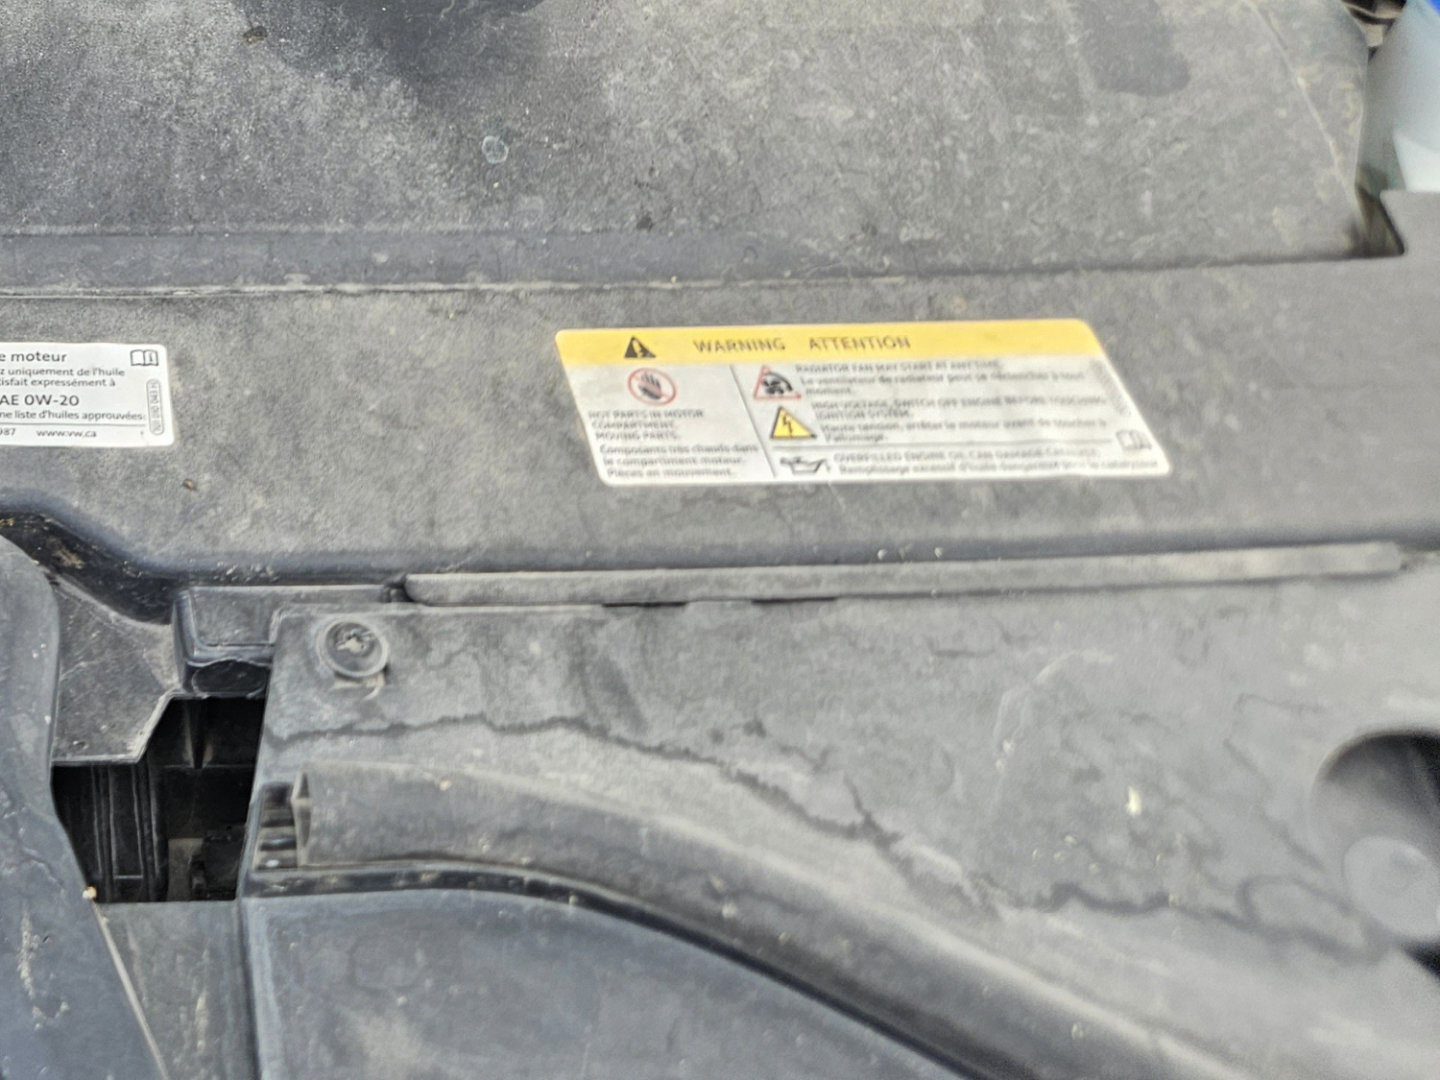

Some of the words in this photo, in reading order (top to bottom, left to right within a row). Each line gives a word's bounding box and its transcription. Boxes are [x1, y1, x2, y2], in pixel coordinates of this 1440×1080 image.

[693, 338, 786, 353] WARNING
[809, 336, 911, 351] ATTENTION
[11, 351, 67, 362] moteur
[8, 368, 73, 378] uniquement
[77, 368, 90, 376] de
[92, 368, 125, 377] l'huile
[30, 378, 107, 388] expressément
[110, 378, 116, 387] à
[24, 394, 80, 407] 0W-20
[14, 409, 37, 419] liste
[39, 410, 79, 419] d'huiles
[36, 429, 97, 438] www.vw.ca
